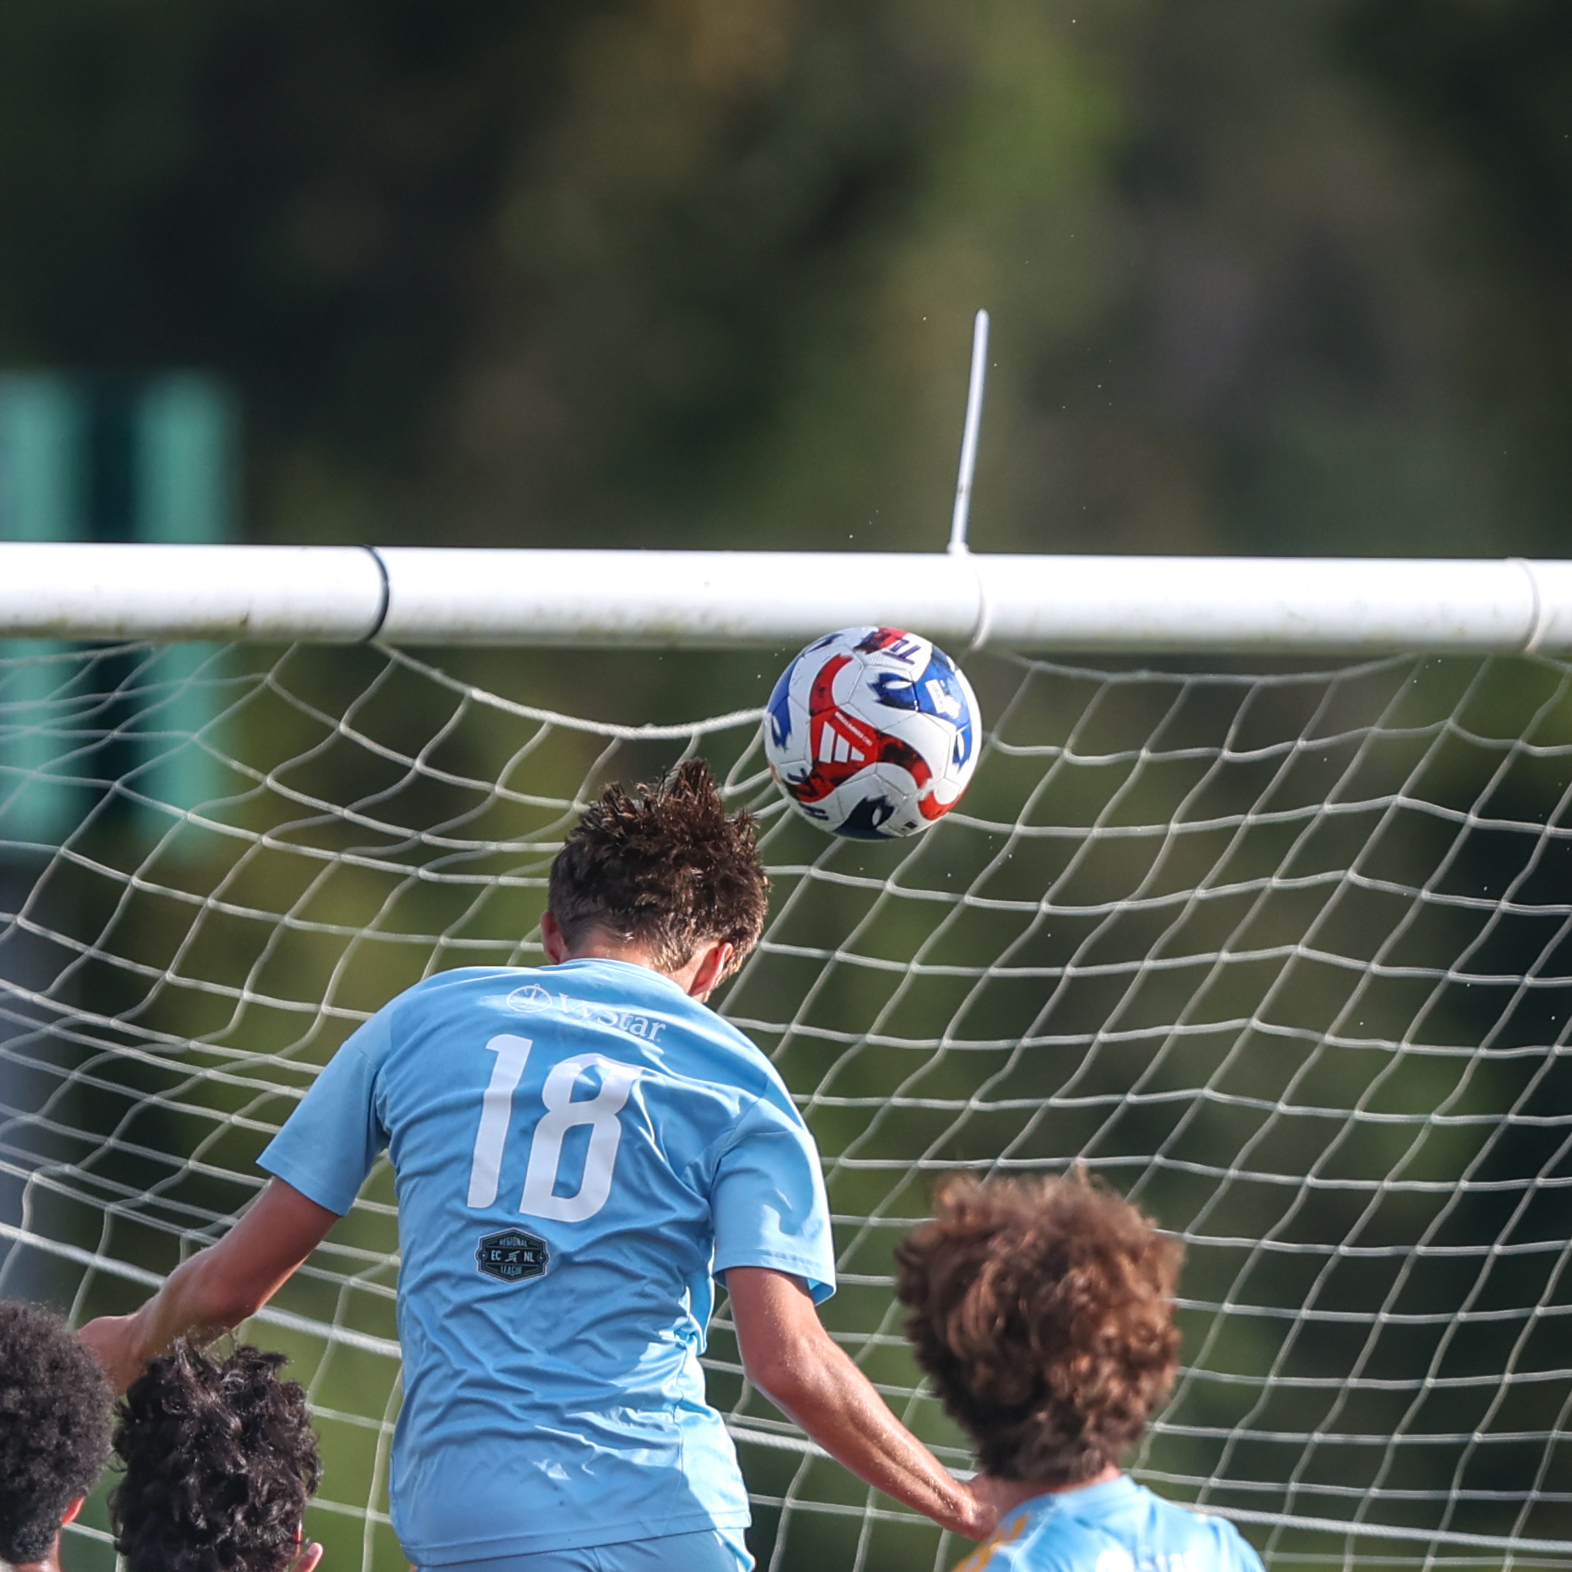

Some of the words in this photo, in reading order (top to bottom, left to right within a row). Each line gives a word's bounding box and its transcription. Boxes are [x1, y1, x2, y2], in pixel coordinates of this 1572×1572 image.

[467, 1034, 642, 1223] 18
[491, 1250, 502, 1261] EC
[523, 1251, 535, 1262] NL
